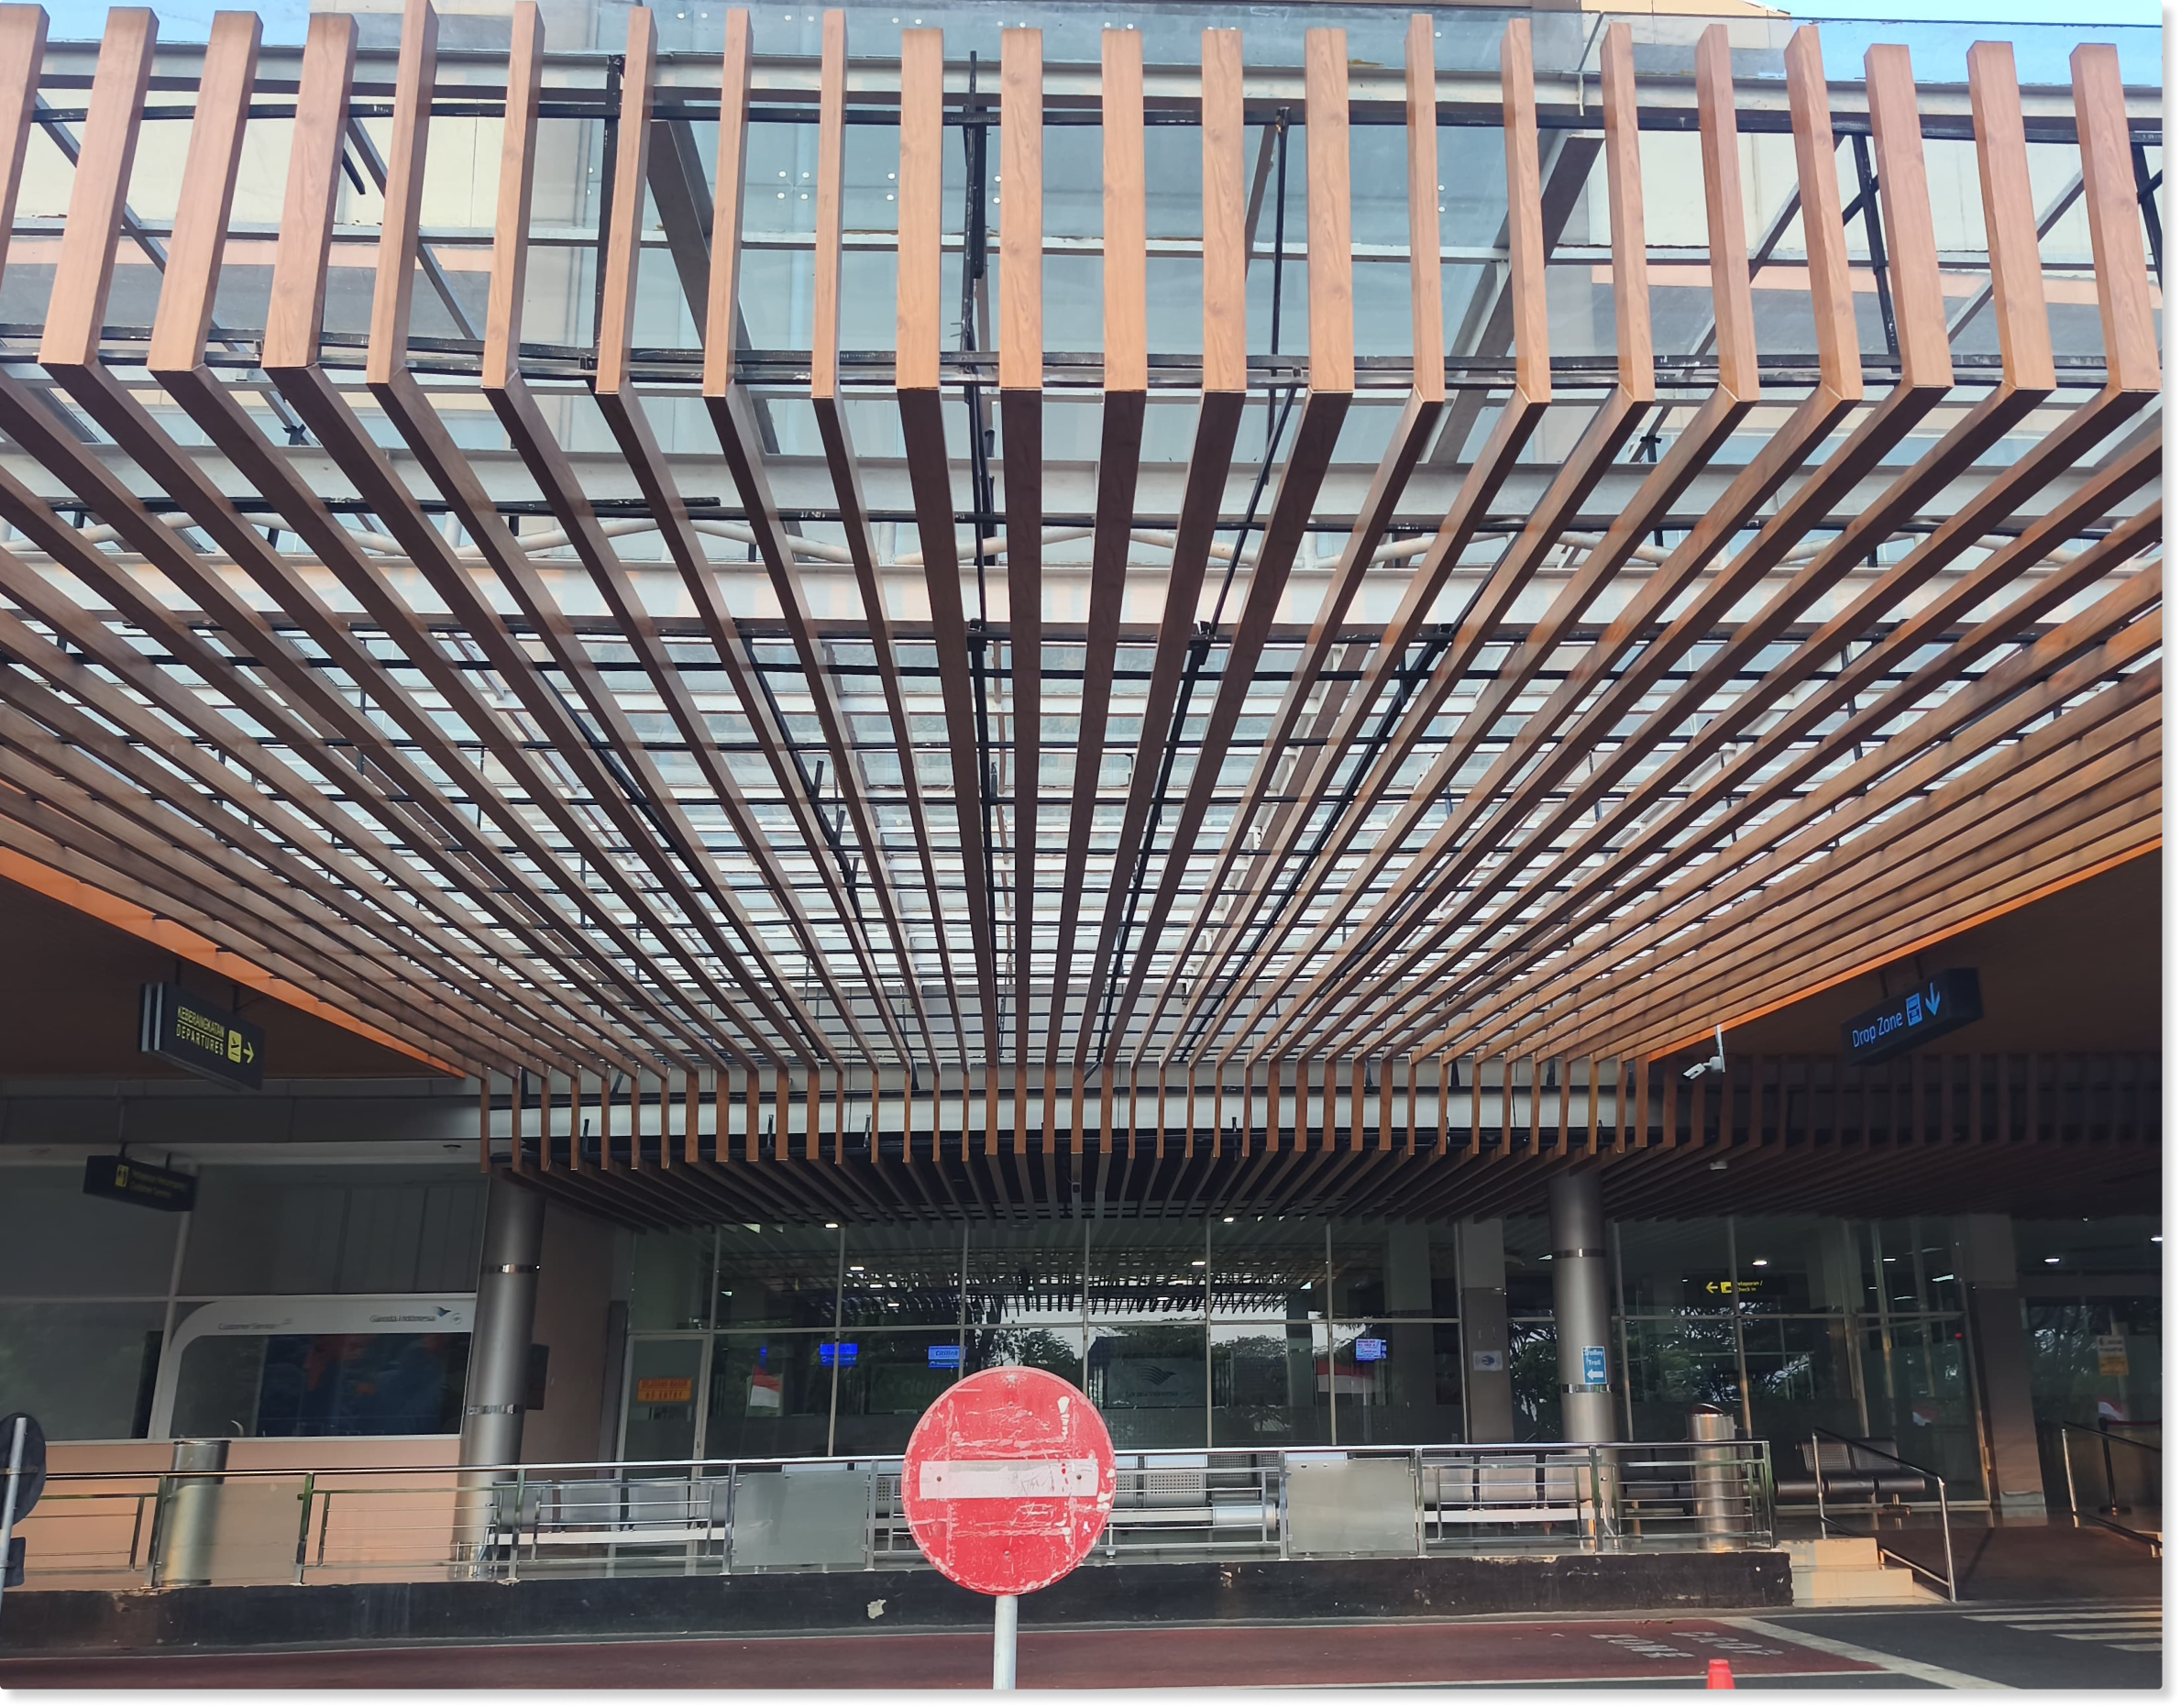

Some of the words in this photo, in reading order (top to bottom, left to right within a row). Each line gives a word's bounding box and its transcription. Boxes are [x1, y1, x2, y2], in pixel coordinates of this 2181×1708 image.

[176, 1023, 224, 1056] DEPARTURES
[1852, 1025, 1877, 1048] Drop
[1877, 1012, 1903, 1036] Zone
